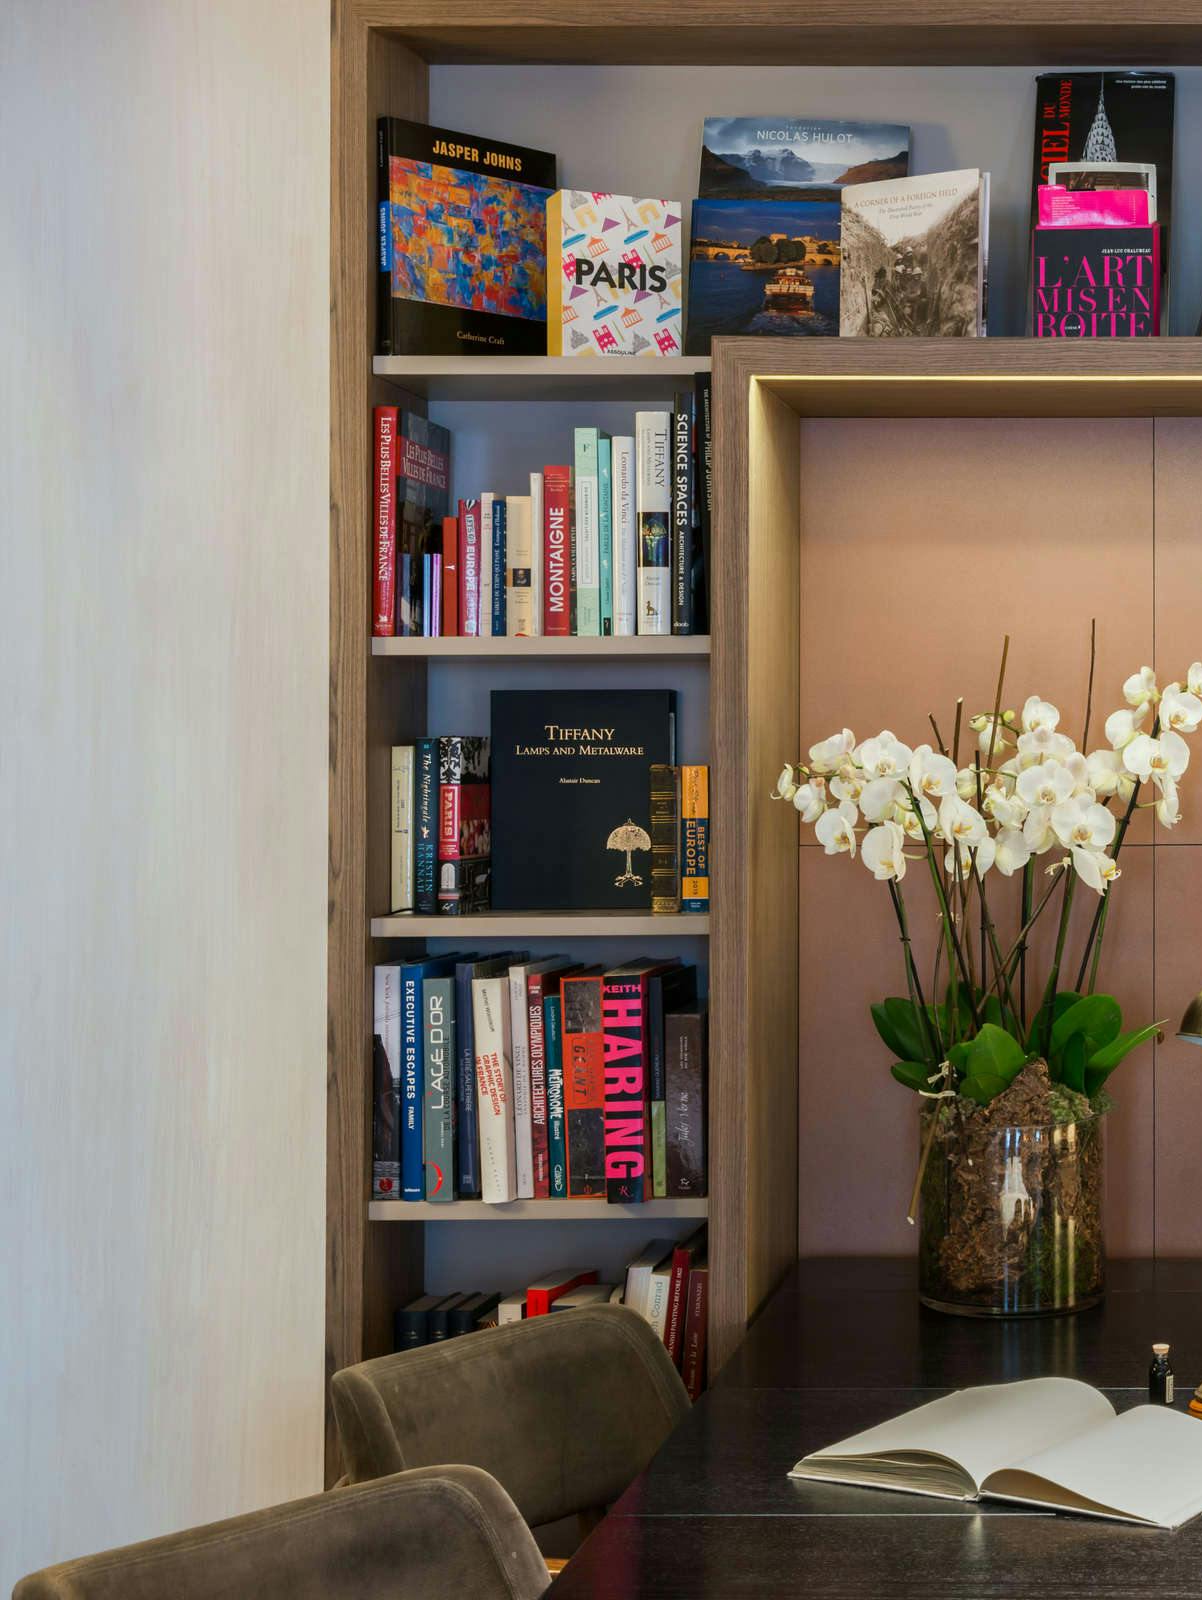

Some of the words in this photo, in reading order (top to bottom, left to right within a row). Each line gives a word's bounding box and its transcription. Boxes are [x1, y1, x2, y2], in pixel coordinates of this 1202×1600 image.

[1043, 102, 1056, 119] DU
[1058, 79, 1072, 119] MONDE
[756, 130, 809, 142] NICOLAS
[813, 132, 853, 144] HULOT
[432, 140, 480, 163] JASPER
[483, 151, 523, 172] JOHNS
[860, 197, 888, 208] CORNER
[888, 196, 899, 204] OF
[907, 191, 937, 201] FOREIGN
[938, 188, 958, 197] FIELD
[575, 258, 668, 292] PARIS
[1036, 256, 1153, 288] L'ART
[1037, 288, 1097, 313] MIS
[1108, 288, 1151, 313] EN
[456, 330, 487, 343] Catherine
[380, 417, 392, 434] LES
[379, 434, 392, 459] PLUS
[654, 428, 668, 488] TIFFANY
[676, 413, 689, 471] SCIENCE
[379, 459, 391, 494] BELLES
[620, 451, 630, 490] Leonardo
[379, 494, 391, 526] VILLES
[620, 491, 629, 501] da
[676, 475, 688, 526] SPACES
[620, 501, 630, 524] Vinci
[379, 526, 389, 539] DE
[378, 541, 390, 581] FRANCE
[465, 545, 476, 591] EUROPE
[549, 506, 565, 613] MONTAIGNE
[678, 530, 686, 575] ARCHITECTURE
[678, 582, 686, 606] DESIGN
[544, 725, 615, 741] TIFFANY
[422, 752, 432, 771] The
[515, 745, 550, 756] LAMPS
[552, 747, 576, 756] AND
[579, 745, 645, 756] METALWARE
[420, 774, 432, 823] Nightingale
[444, 791, 453, 836] PARIS
[686, 820, 696, 876] EUROPE
[697, 826, 705, 851] BEST
[417, 843, 425, 893] HANNAH
[425, 843, 434, 892] KRISTIN
[697, 854, 705, 869] OF
[602, 984, 642, 993] KEITH
[405, 980, 415, 1043] EXECUTIVE
[427, 995, 444, 1044] D'OR
[529, 1005, 543, 1058] OLYMPIQUES
[405, 1047, 415, 1099] ESCAPES
[490, 1052, 500, 1068] THE
[477, 1066, 489, 1096] FRANCE
[482, 1054, 497, 1088] GRAPHIC
[490, 1088, 502, 1116] DESIGN
[493, 1068, 505, 1092] STORY
[531, 1059, 545, 1125] ARCHITECTURES
[602, 998, 645, 1180] HARING
[499, 1093, 507, 1103] OF
[652, 1281, 663, 1318] Conrad
[671, 1302, 679, 1331] PAINTING
